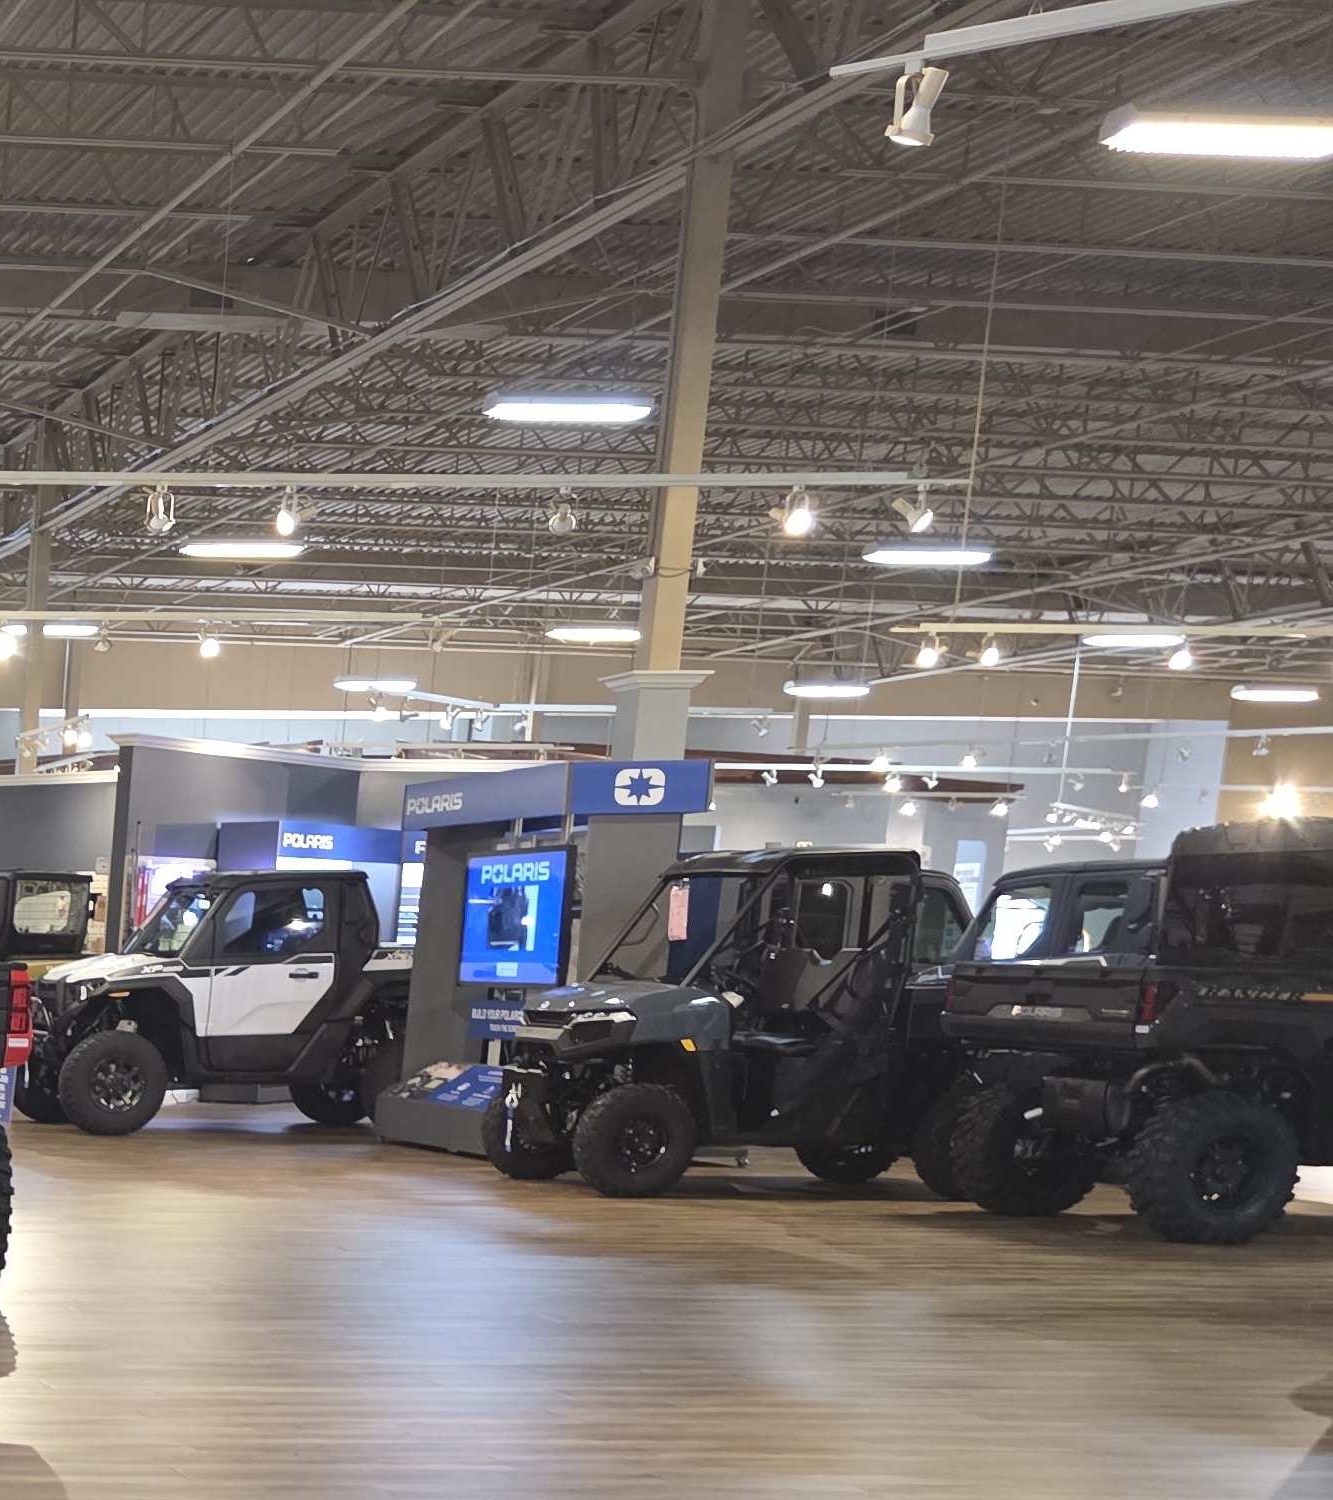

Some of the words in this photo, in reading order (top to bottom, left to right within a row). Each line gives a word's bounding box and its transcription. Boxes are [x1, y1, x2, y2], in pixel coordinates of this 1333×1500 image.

[406, 792, 463, 816] POLARIS
[283, 832, 334, 850] POLARIS
[481, 861, 550, 884] POLARIS
